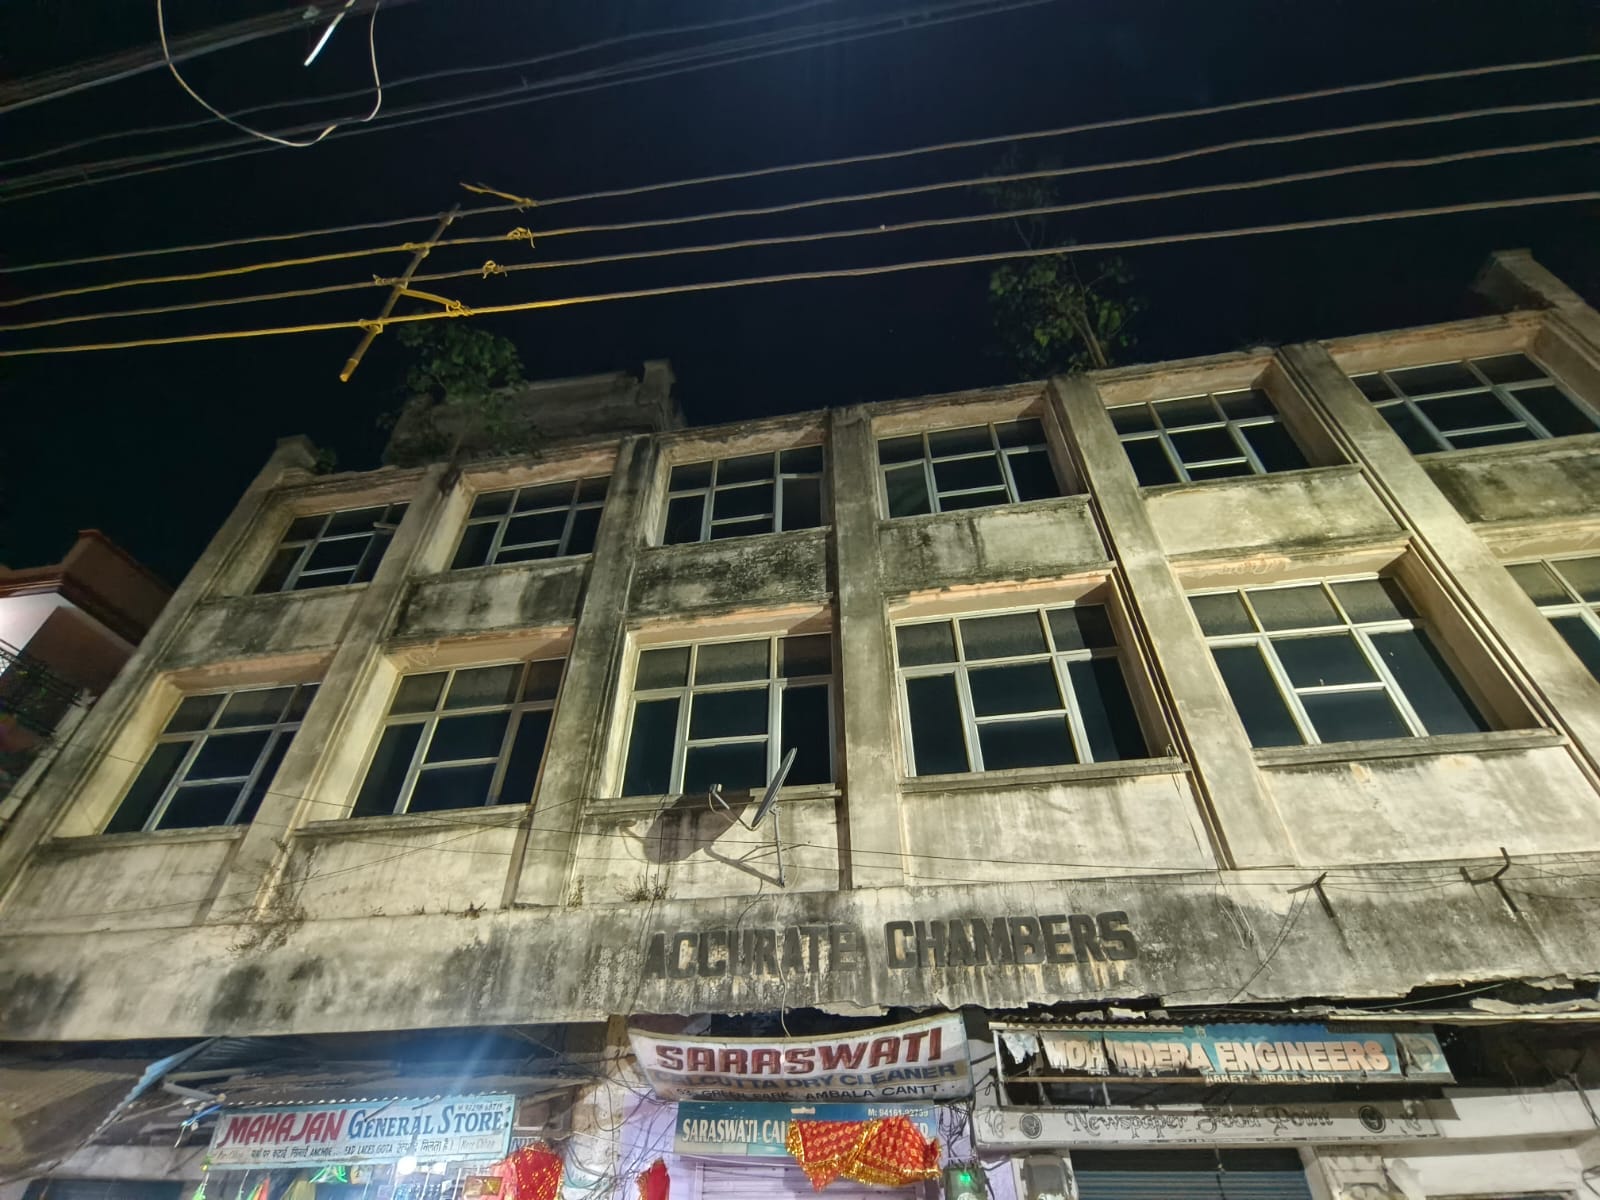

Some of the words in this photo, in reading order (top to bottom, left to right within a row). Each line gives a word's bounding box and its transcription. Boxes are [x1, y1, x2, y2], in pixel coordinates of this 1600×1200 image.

[643, 923, 862, 979] ACCURATE
[884, 910, 1139, 970] CHAMBERS
[655, 1026, 943, 1076] SARASWATI
[1214, 1041, 1391, 1073] ENGINEERS
[786, 1074, 834, 1089] DRY
[839, 1063, 957, 1086] CLEANER
[805, 1089, 875, 1101] AMBALA
[216, 1109, 347, 1149] MAHAJAN
[348, 1108, 434, 1140] GENERAL
[437, 1102, 503, 1134] STORE
[681, 1118, 758, 1143] SARASWATI
[1064, 1108, 1188, 1139] Newspaper
[1263, 1106, 1334, 1136] Point
